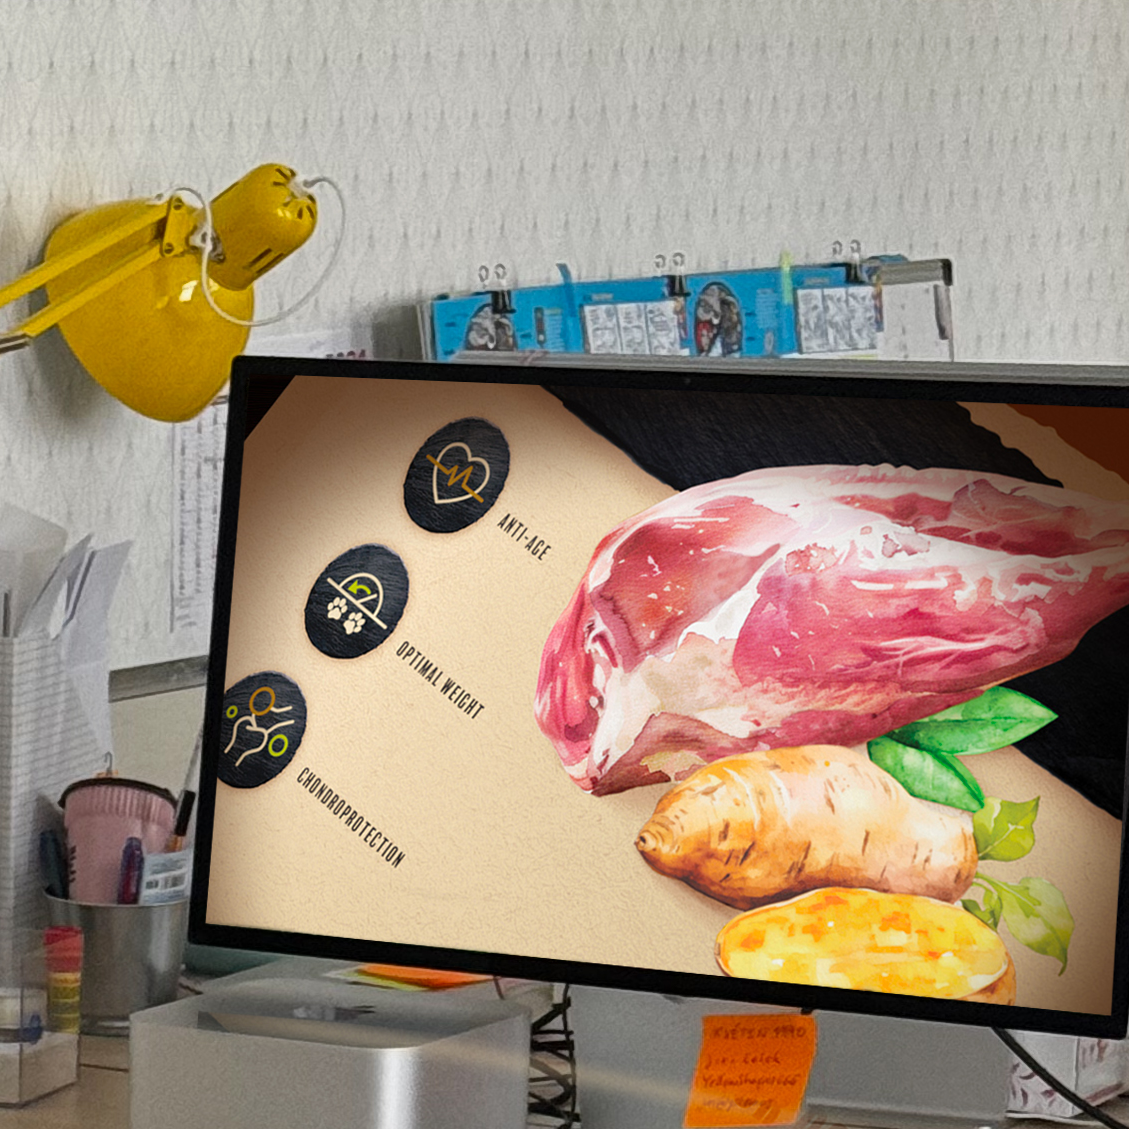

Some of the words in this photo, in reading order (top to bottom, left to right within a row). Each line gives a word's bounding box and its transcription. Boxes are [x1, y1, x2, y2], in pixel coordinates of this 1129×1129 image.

[497, 513, 551, 561] ANTI-AGE
[396, 641, 444, 687] OPTIMAL
[440, 677, 485, 719] WEIGHT
[296, 767, 406, 869] CHONDROPROTECTION
